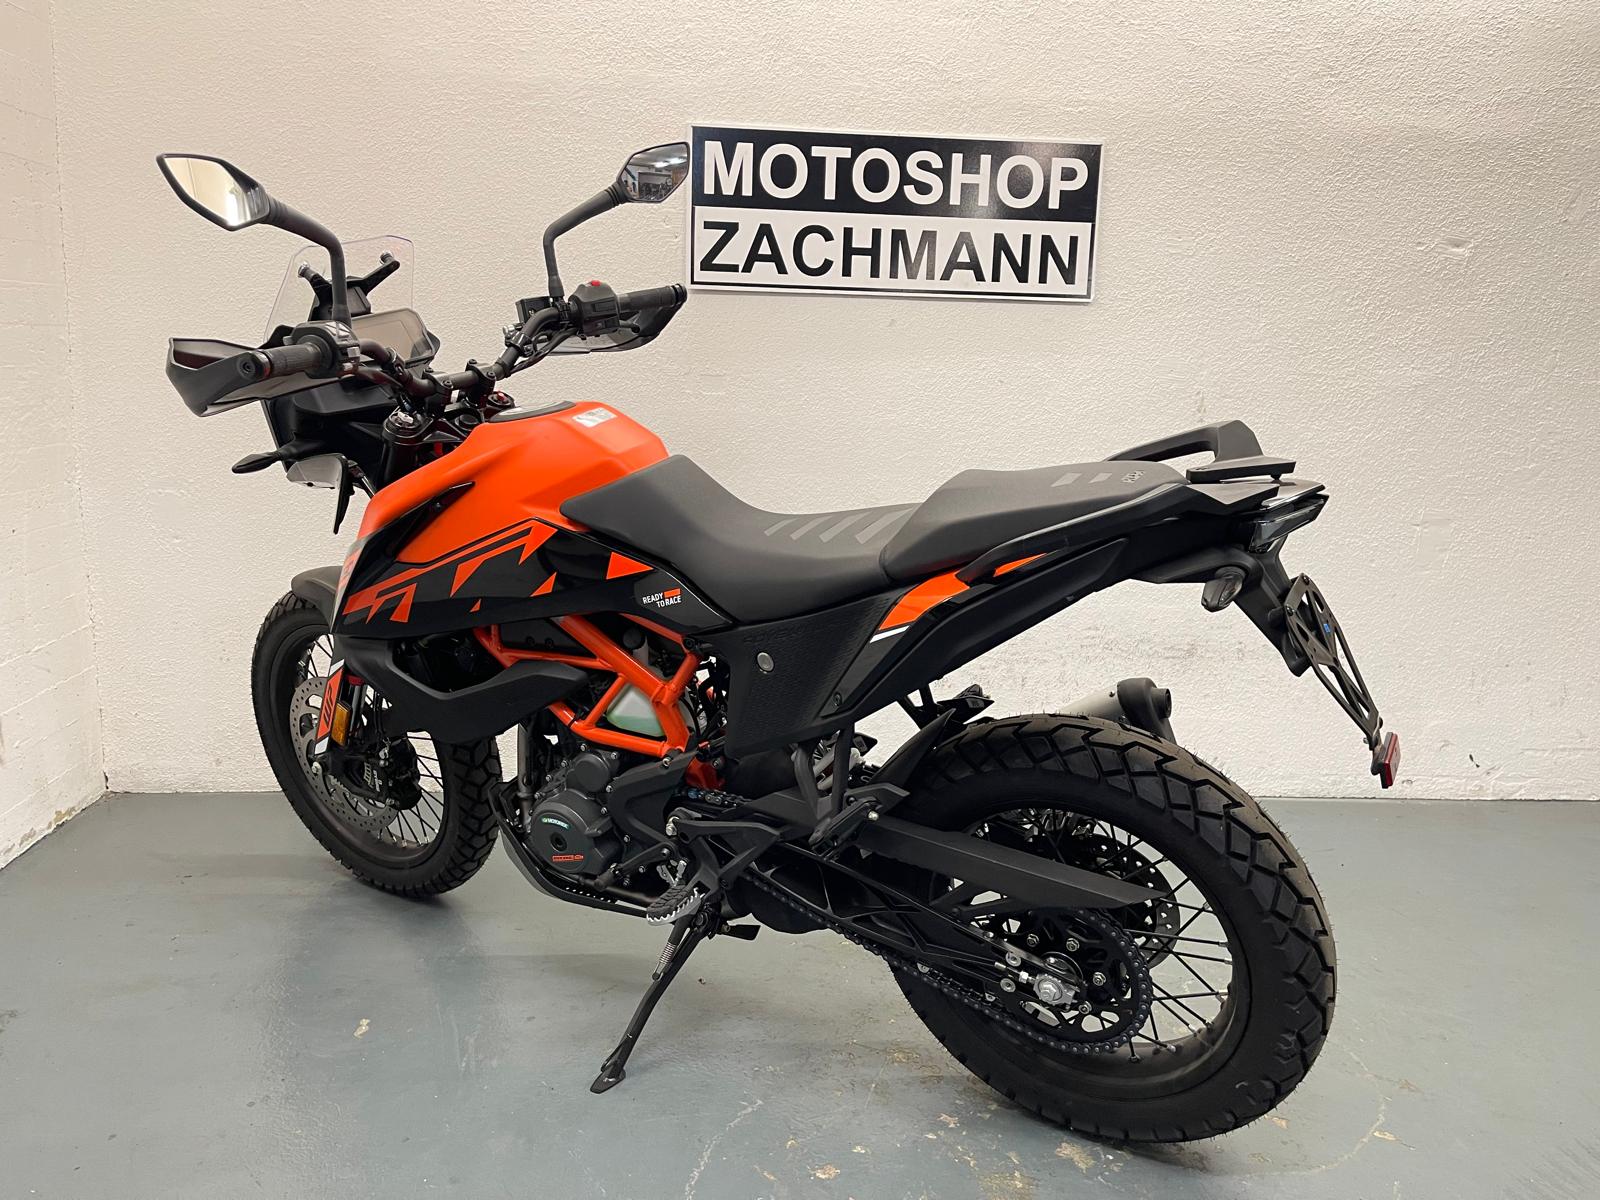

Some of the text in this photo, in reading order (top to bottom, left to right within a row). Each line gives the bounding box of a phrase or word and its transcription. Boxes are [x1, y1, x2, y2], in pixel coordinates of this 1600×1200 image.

[703, 140, 1089, 210] MOTOSHOP
[699, 220, 1079, 286] ZACHMANN
[642, 592, 663, 604] READY
[665, 596, 681, 606] RACE
